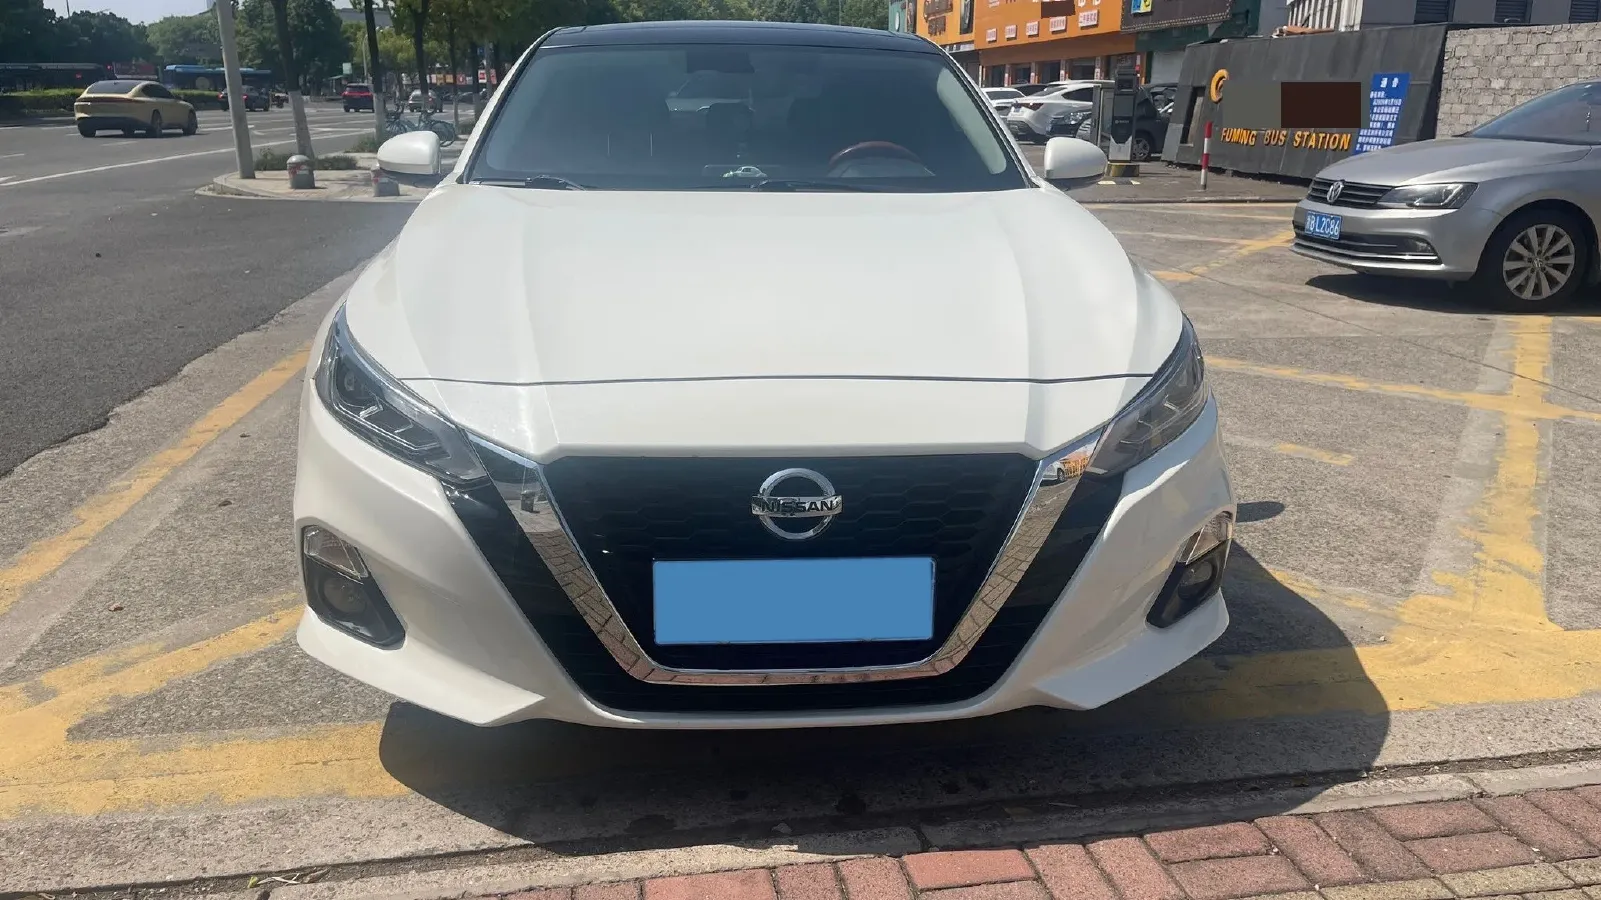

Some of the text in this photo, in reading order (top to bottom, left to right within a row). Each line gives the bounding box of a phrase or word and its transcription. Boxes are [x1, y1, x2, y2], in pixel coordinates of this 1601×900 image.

[1221, 127, 1257, 146] FUMING
[1264, 129, 1287, 146] BUS
[1293, 130, 1351, 151] STATION
[761, 500, 833, 512] NISSAN
